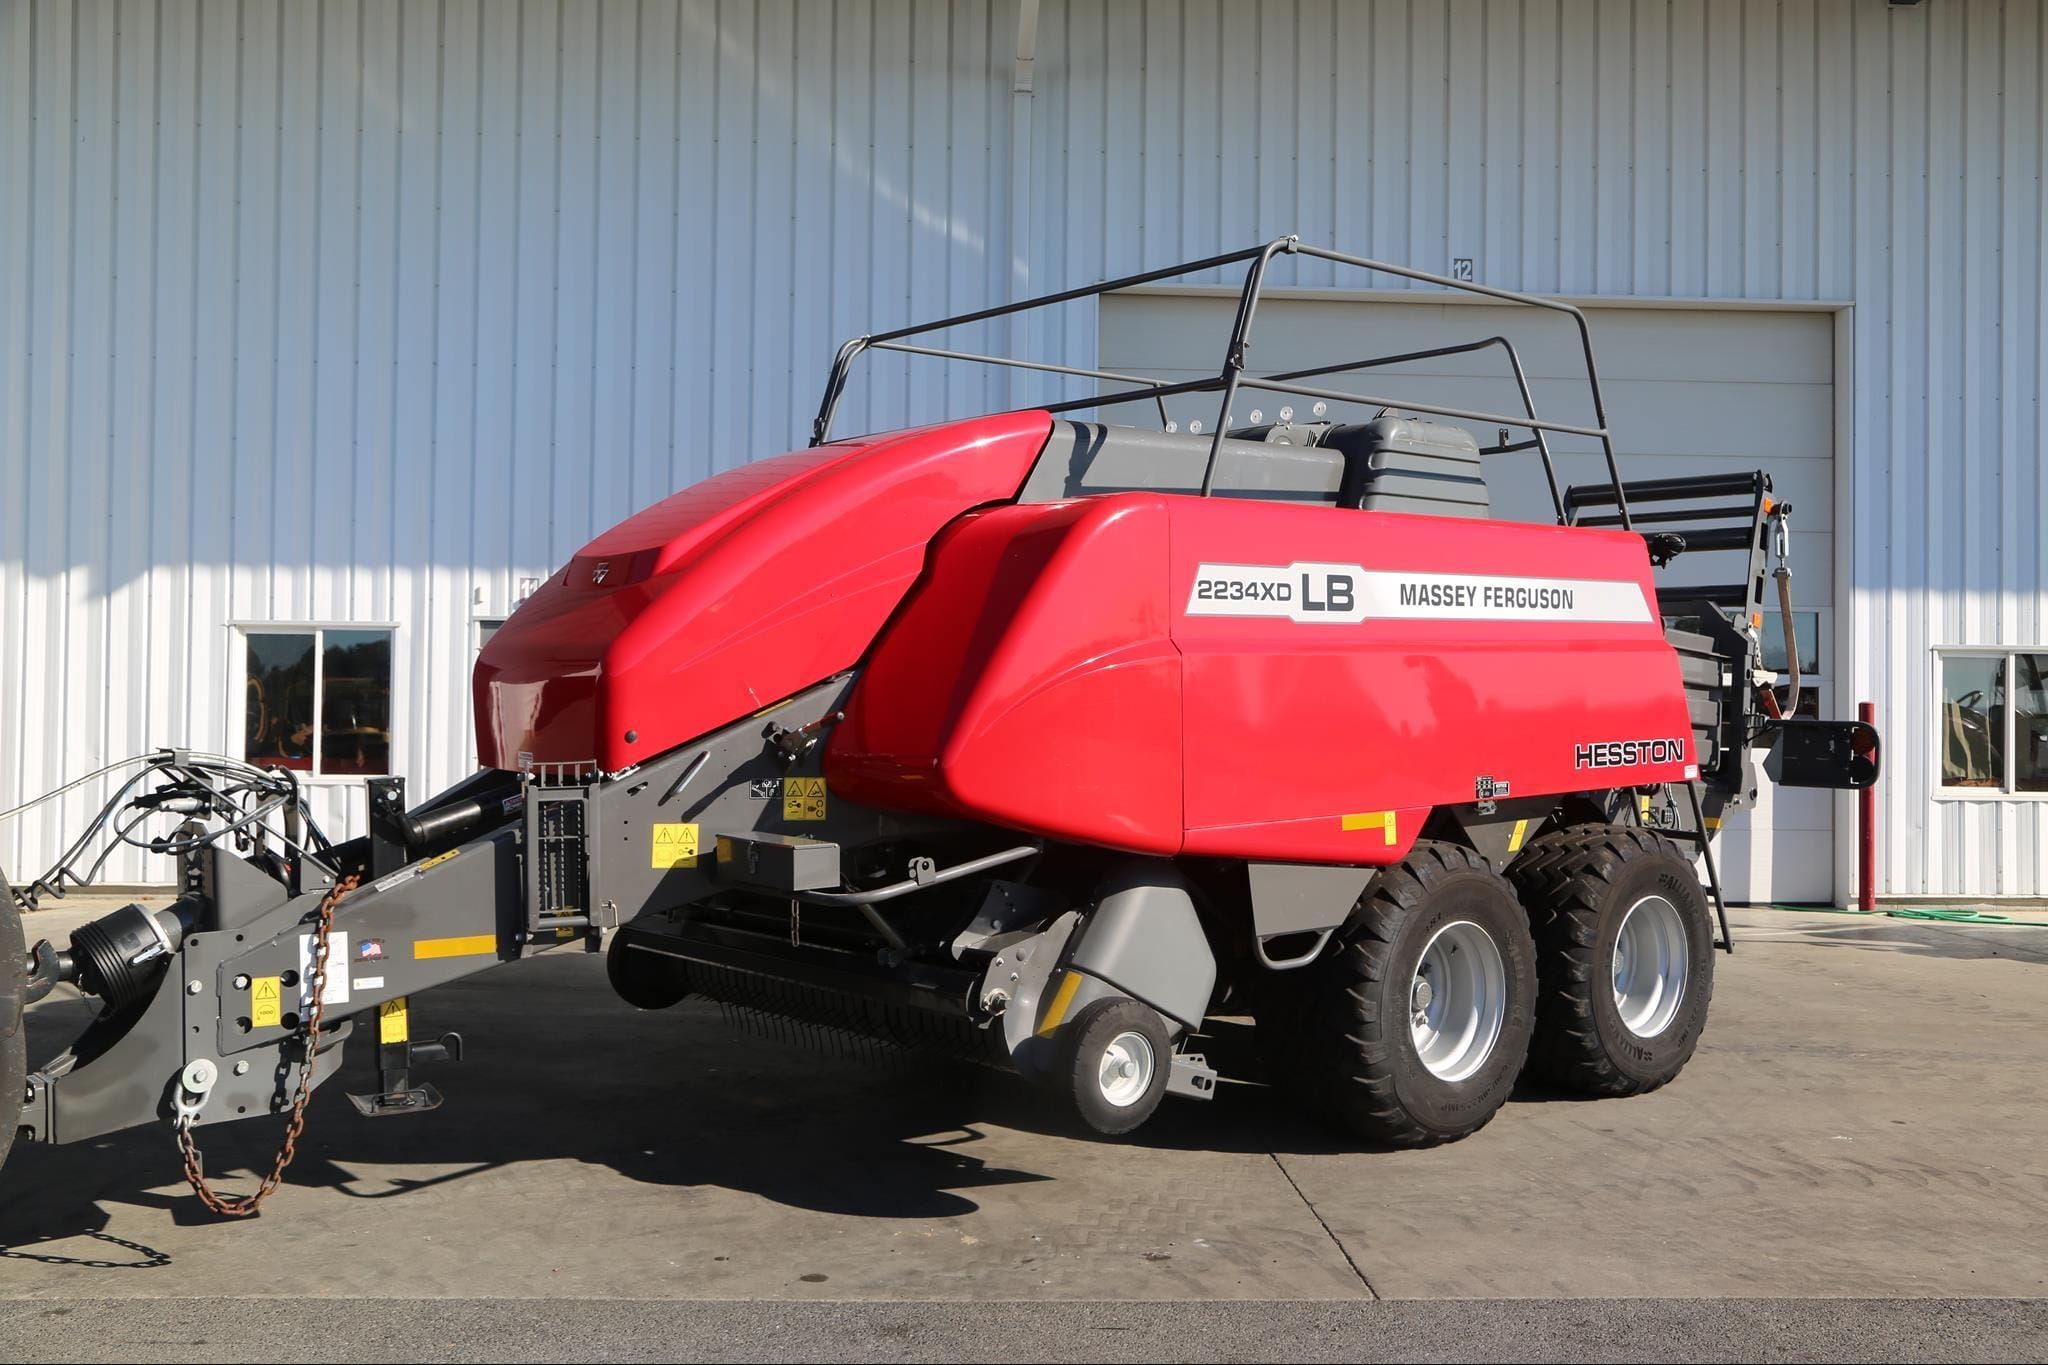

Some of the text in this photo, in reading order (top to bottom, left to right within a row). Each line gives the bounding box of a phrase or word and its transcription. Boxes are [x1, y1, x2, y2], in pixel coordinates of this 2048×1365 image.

[1454, 260, 1472, 281] 12
[1197, 573, 1574, 613] 2234XD LB MASSEY FERGUSON
[1575, 738, 1684, 770] HESSTON
